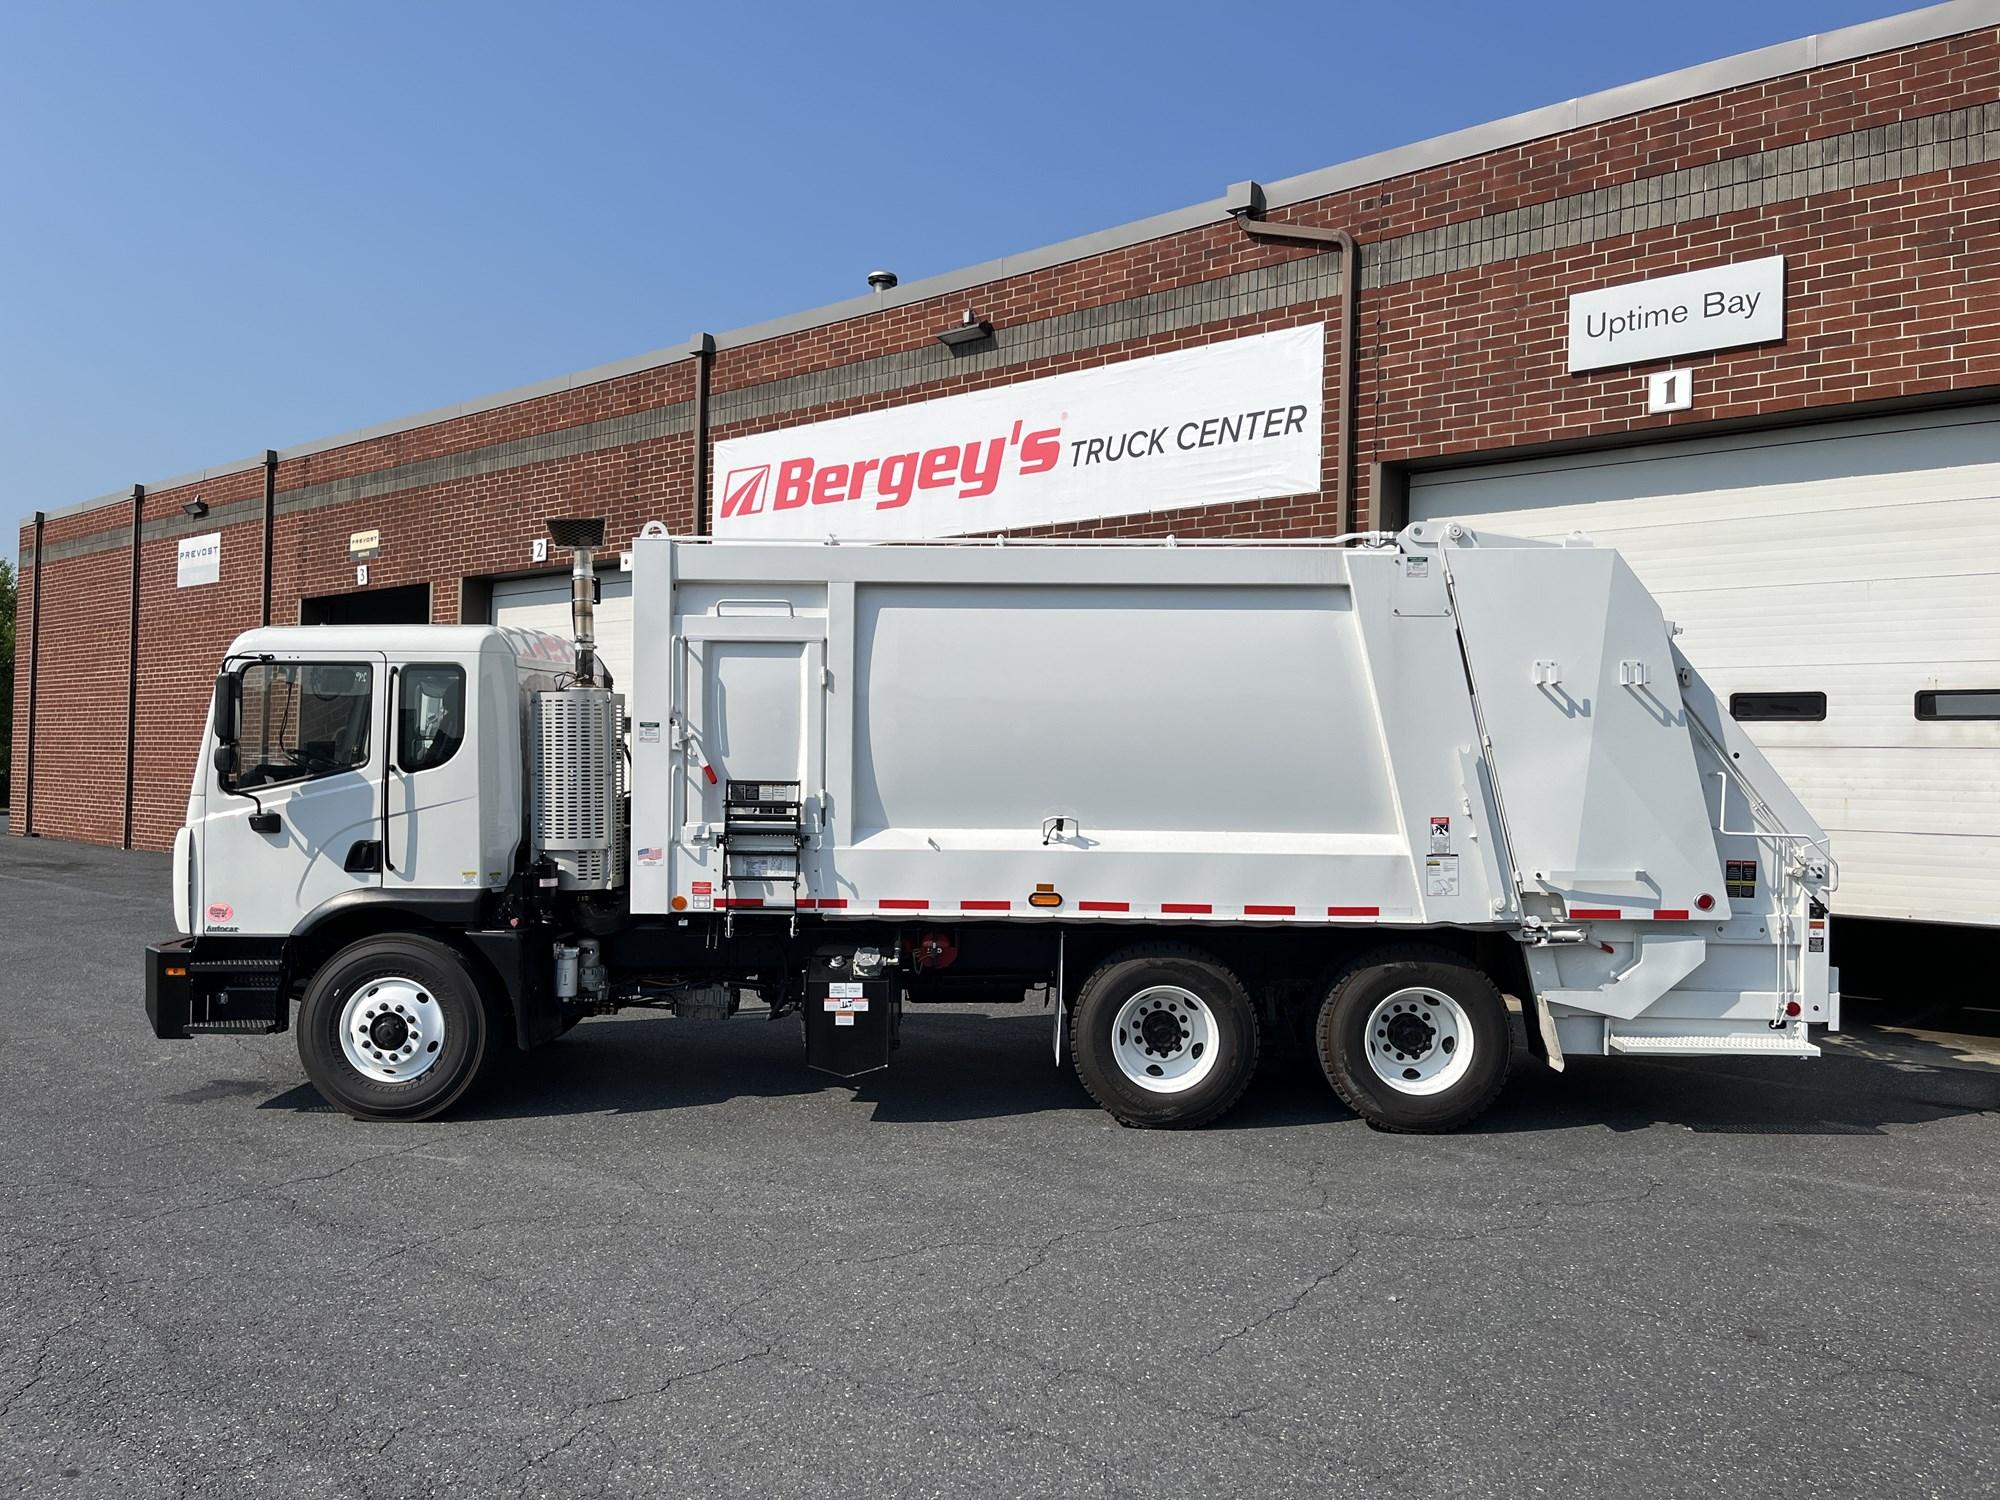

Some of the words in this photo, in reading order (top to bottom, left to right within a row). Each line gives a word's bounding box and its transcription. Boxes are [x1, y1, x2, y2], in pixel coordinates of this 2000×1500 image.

[1587, 305, 1688, 341] Uptime
[1703, 291, 1761, 319] Bay
[1663, 375, 1677, 405] 1
[773, 419, 1061, 511] Bergey's
[1070, 426, 1169, 467] TRUCK
[1176, 404, 1308, 450] CENTER
[179, 545, 219, 560] PREVOST
[536, 542, 543, 557] 2
[359, 568, 365, 582] 3
